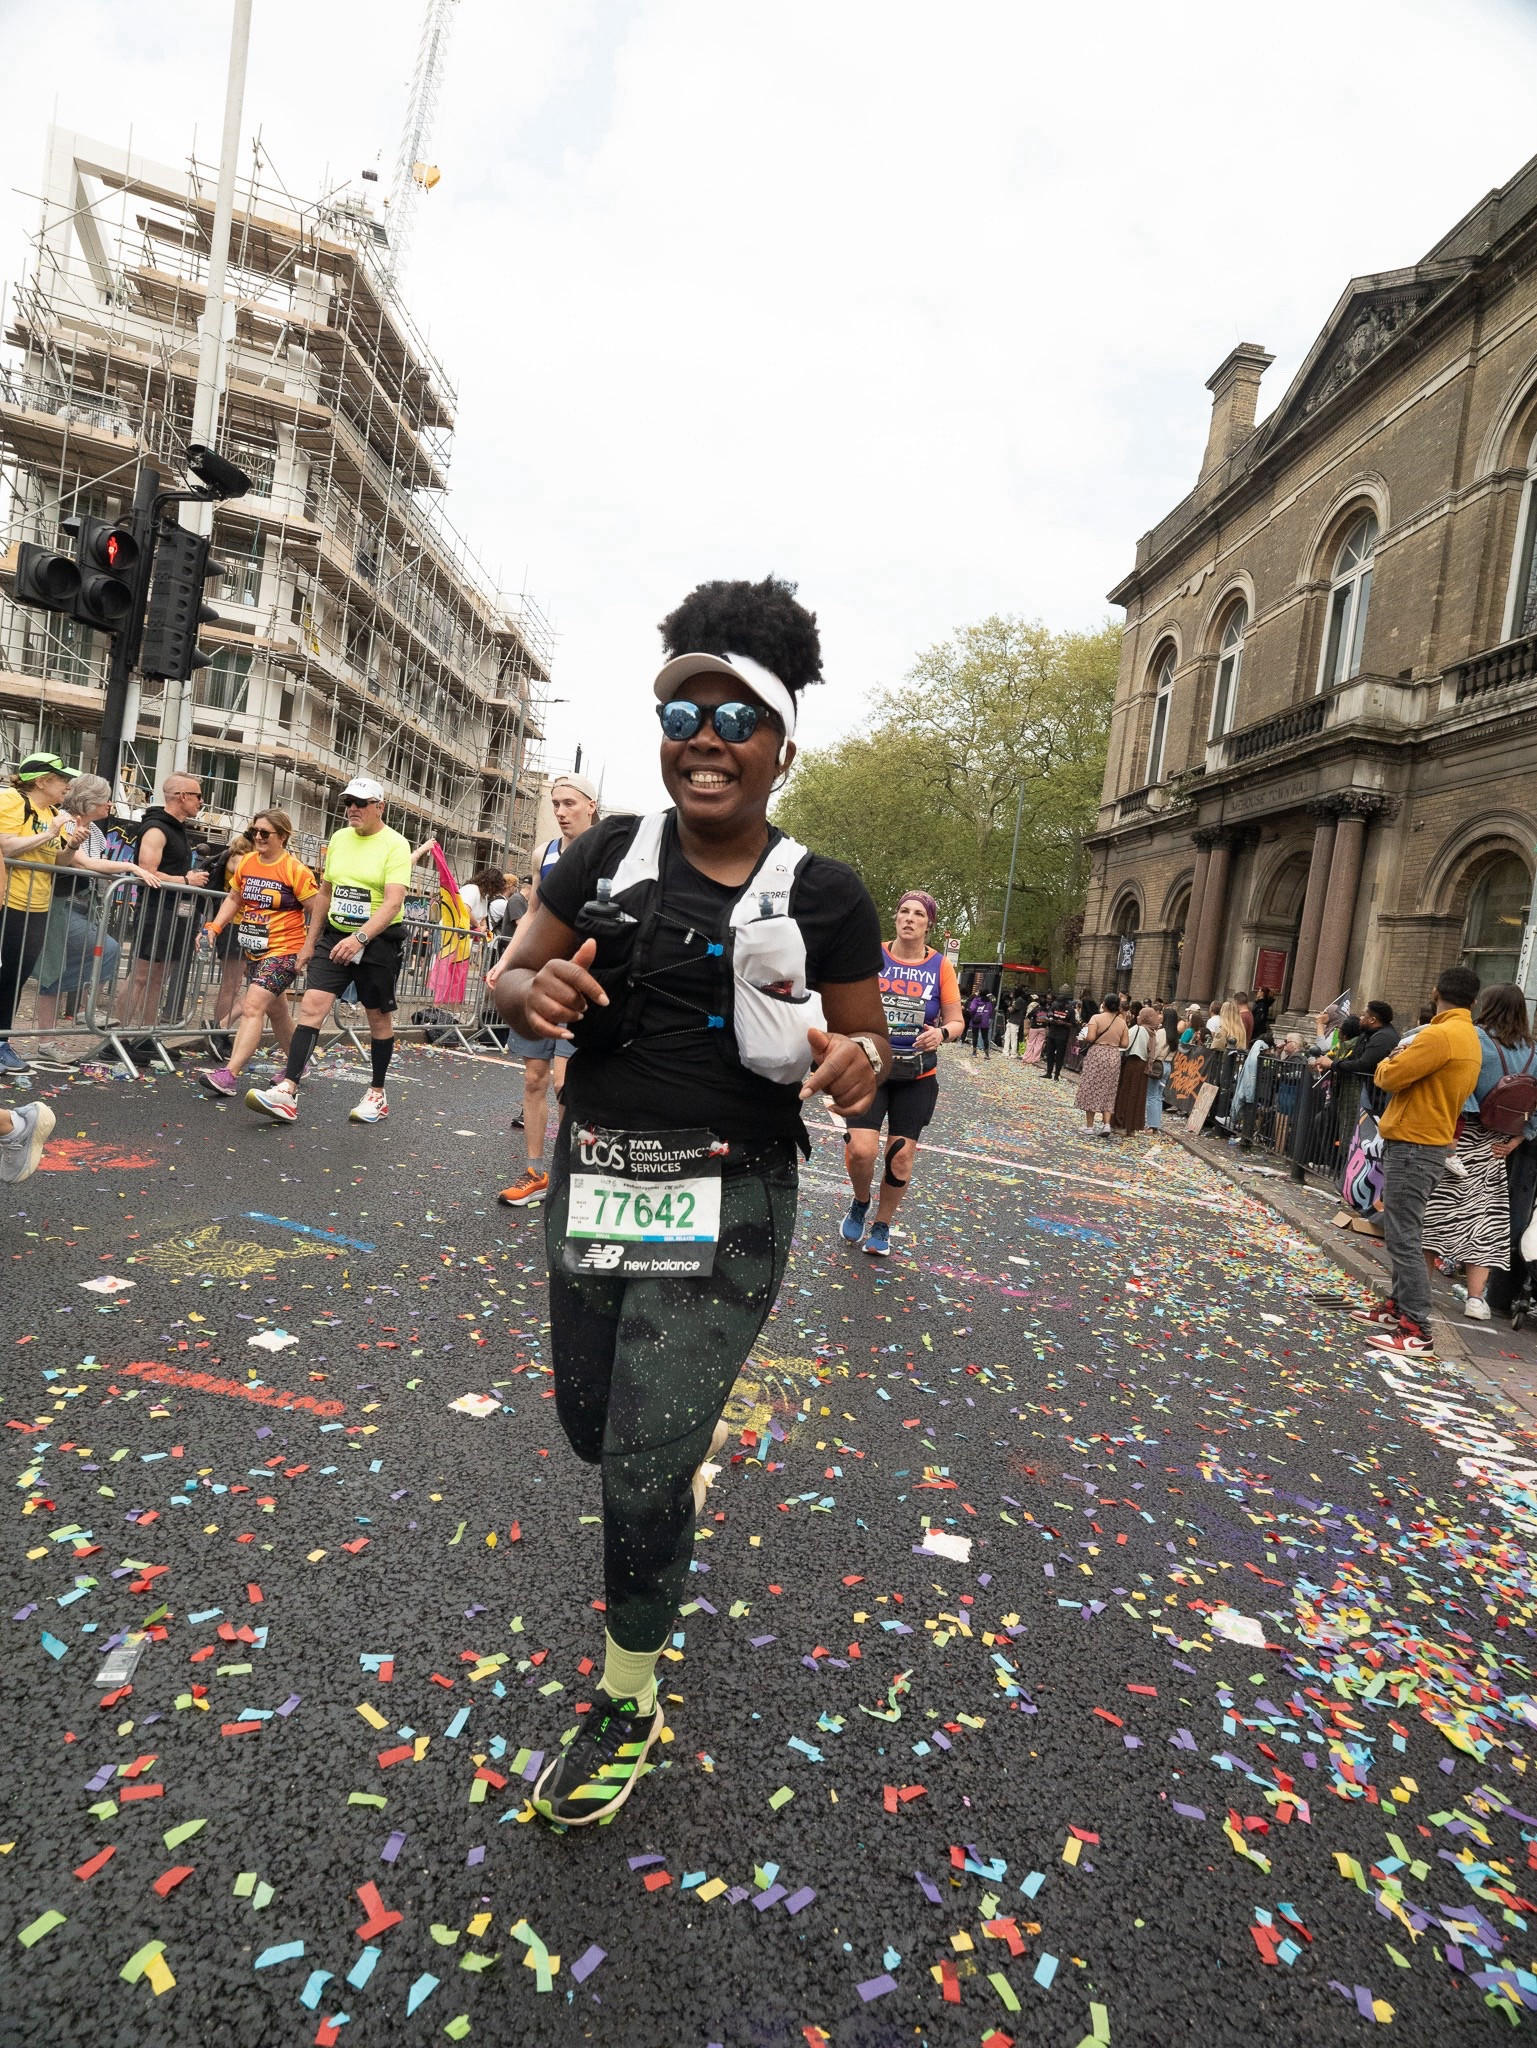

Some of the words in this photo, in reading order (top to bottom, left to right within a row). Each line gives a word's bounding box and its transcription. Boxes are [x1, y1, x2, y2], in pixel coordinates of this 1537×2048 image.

[244, 885, 261, 894] WITH
[246, 877, 282, 891] CHILDREN
[242, 893, 272, 904] CANCER
[337, 901, 364, 915] 74036
[240, 936, 262, 950] 64015
[628, 1139, 663, 1150] TATA
[628, 1147, 707, 1162] CONSULTANC
[630, 1162, 682, 1173] SERVICES
[593, 1189, 696, 1229] 77642
[623, 1259, 653, 1271] new
[651, 1258, 701, 1272] balance
